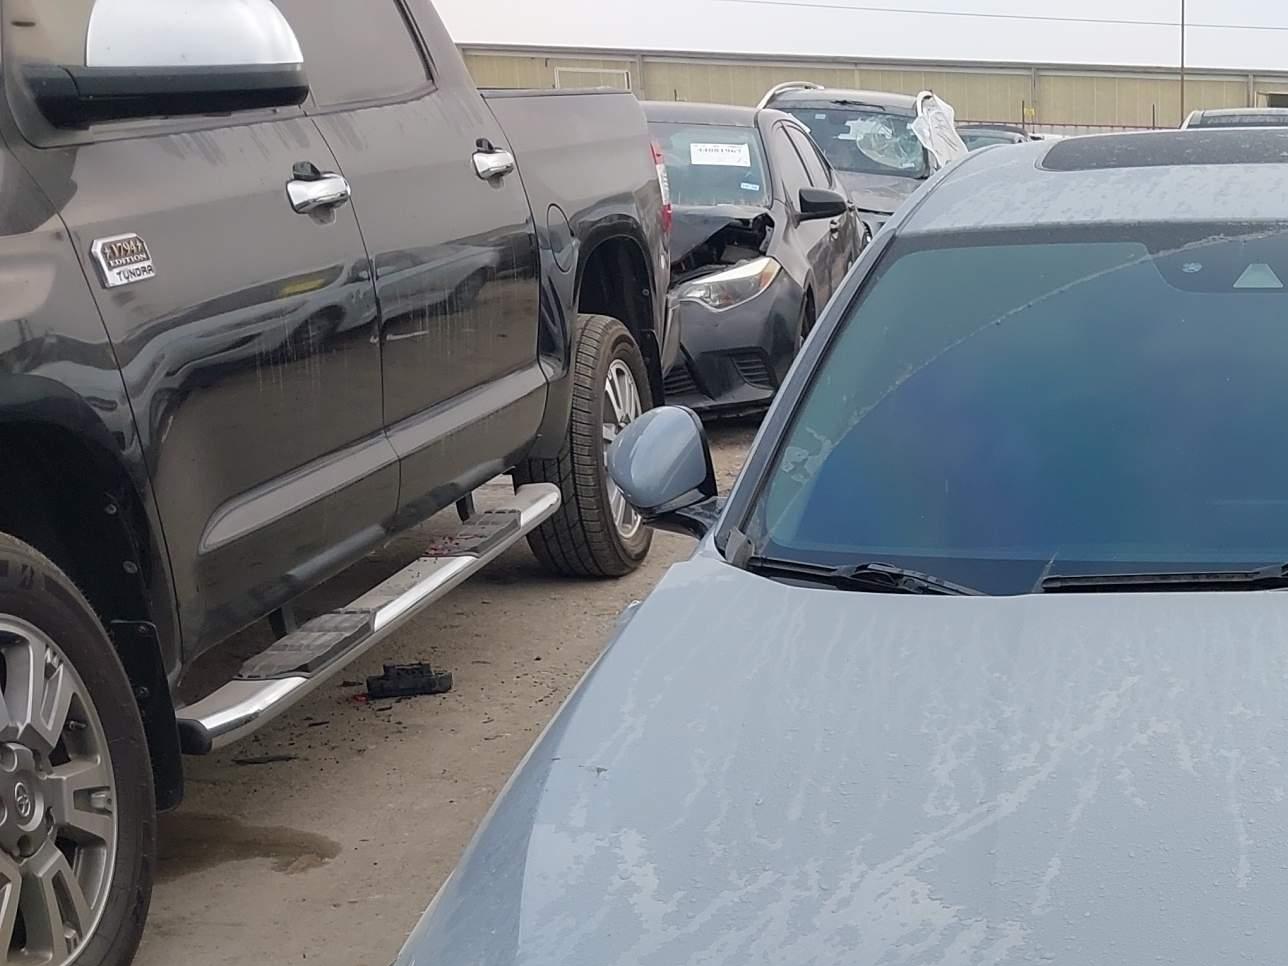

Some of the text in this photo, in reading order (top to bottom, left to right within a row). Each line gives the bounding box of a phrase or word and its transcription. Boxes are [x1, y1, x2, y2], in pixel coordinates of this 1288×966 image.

[111, 240, 137, 257] 1794
[109, 253, 147, 267] EDITION
[116, 264, 153, 281] TUNDRA
